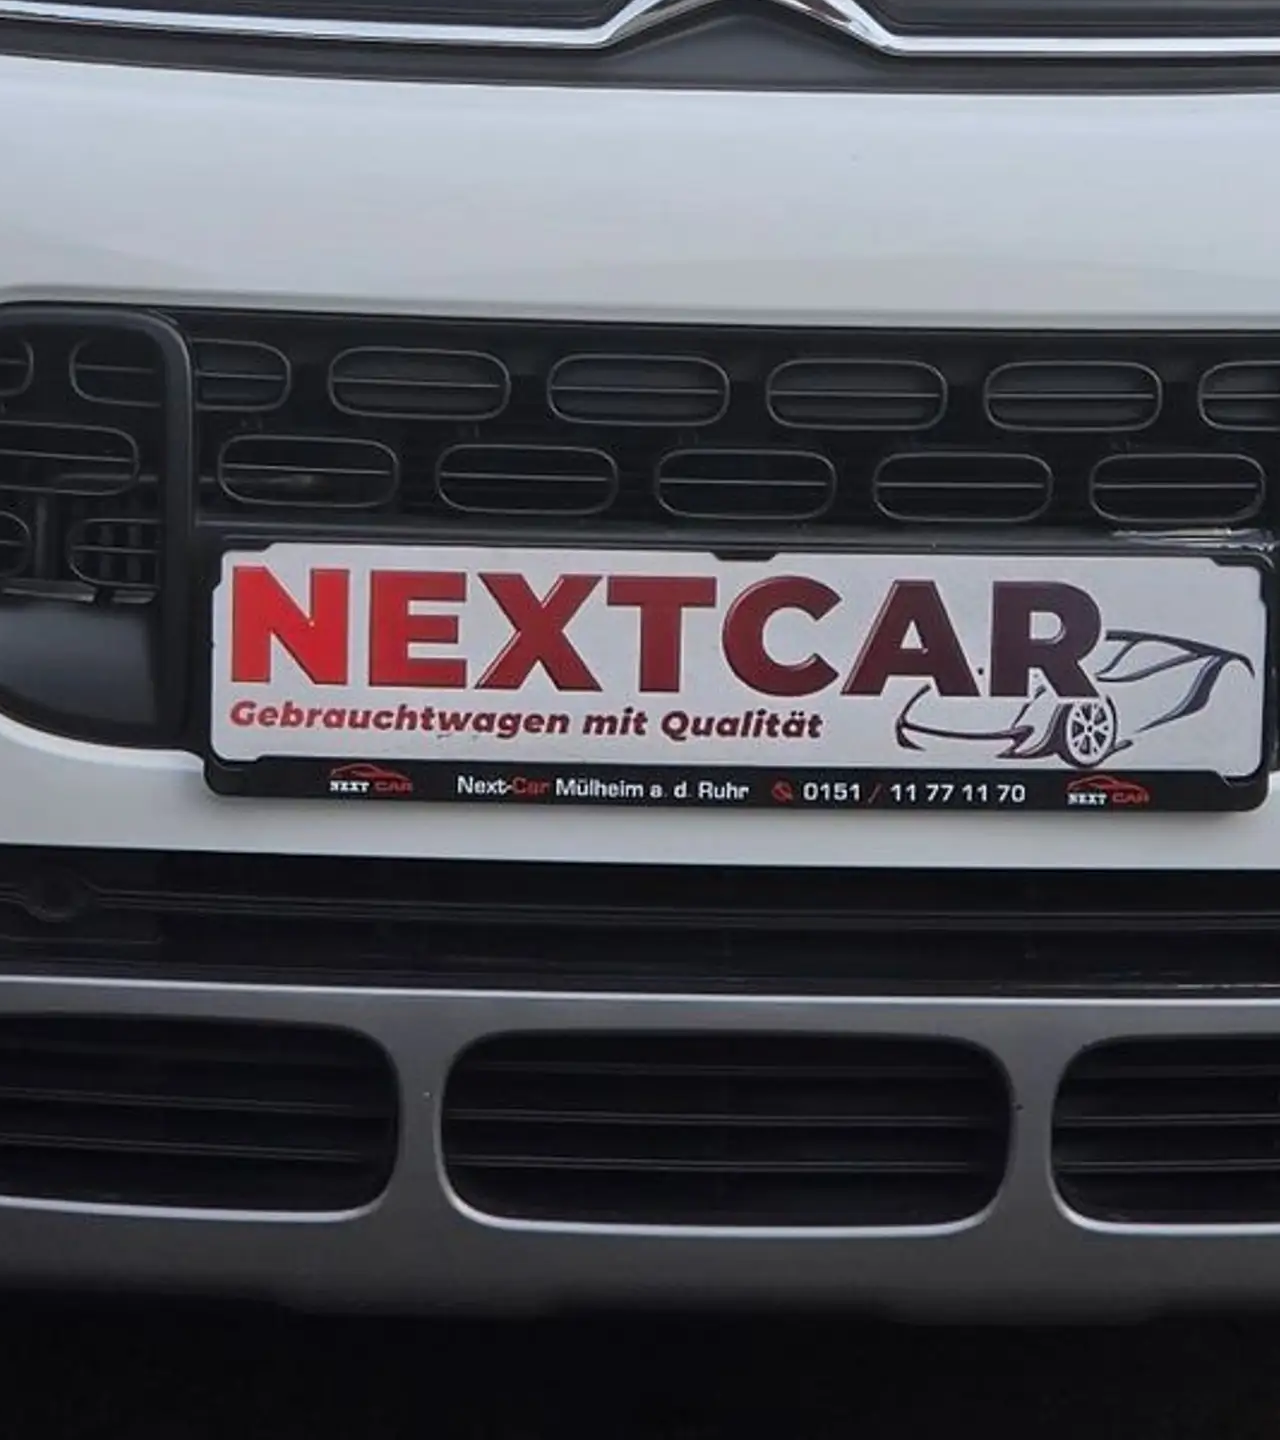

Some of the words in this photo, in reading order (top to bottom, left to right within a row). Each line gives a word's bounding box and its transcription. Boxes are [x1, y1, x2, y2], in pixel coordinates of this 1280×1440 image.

[231, 565, 1102, 698] NEXTCAR
[229, 700, 571, 738] Gebrauchtwagen
[582, 706, 648, 737] mit
[660, 707, 824, 740] Qualität
[329, 780, 370, 793] NEXT
[373, 780, 413, 794] CAR
[456, 775, 550, 796] Next-Car
[555, 778, 644, 798] Mülheim
[698, 781, 750, 800] Ruhr
[802, 782, 861, 802] 0151
[890, 783, 917, 802] 11
[925, 783, 955, 803] 77
[961, 783, 988, 803] 11
[996, 783, 1027, 803] 70
[1067, 792, 1108, 805] NEXT
